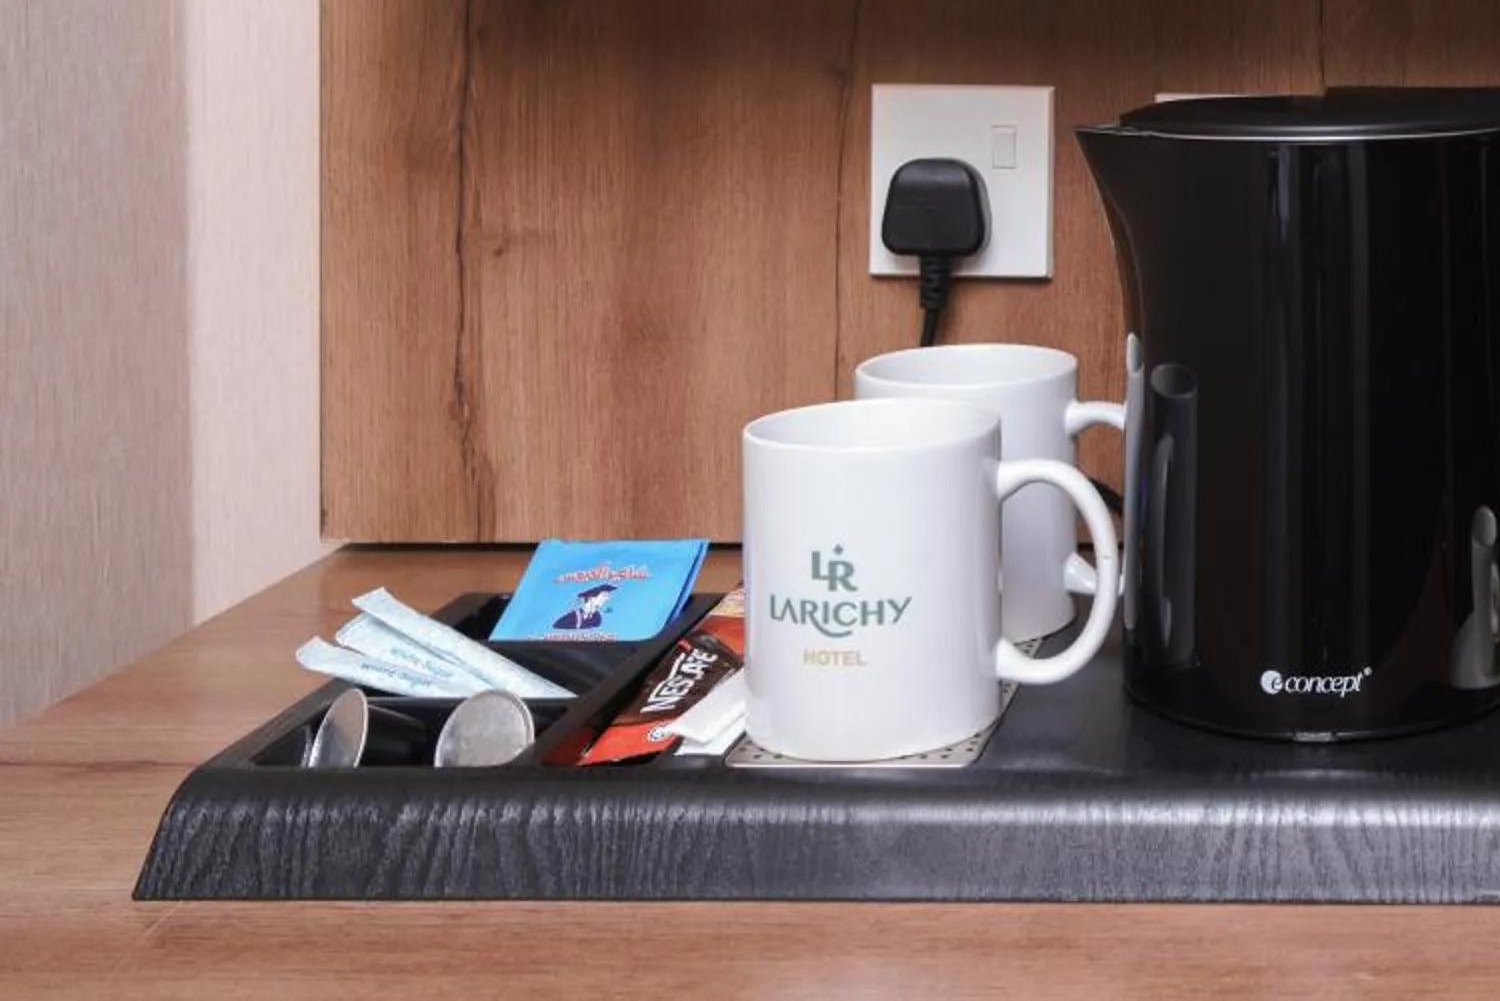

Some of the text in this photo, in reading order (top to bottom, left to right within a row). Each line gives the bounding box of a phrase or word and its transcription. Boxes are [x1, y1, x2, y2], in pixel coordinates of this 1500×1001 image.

[769, 594, 912, 638] LARICHY
[803, 649, 868, 667] HOTEL
[1285, 672, 1364, 698] concept
